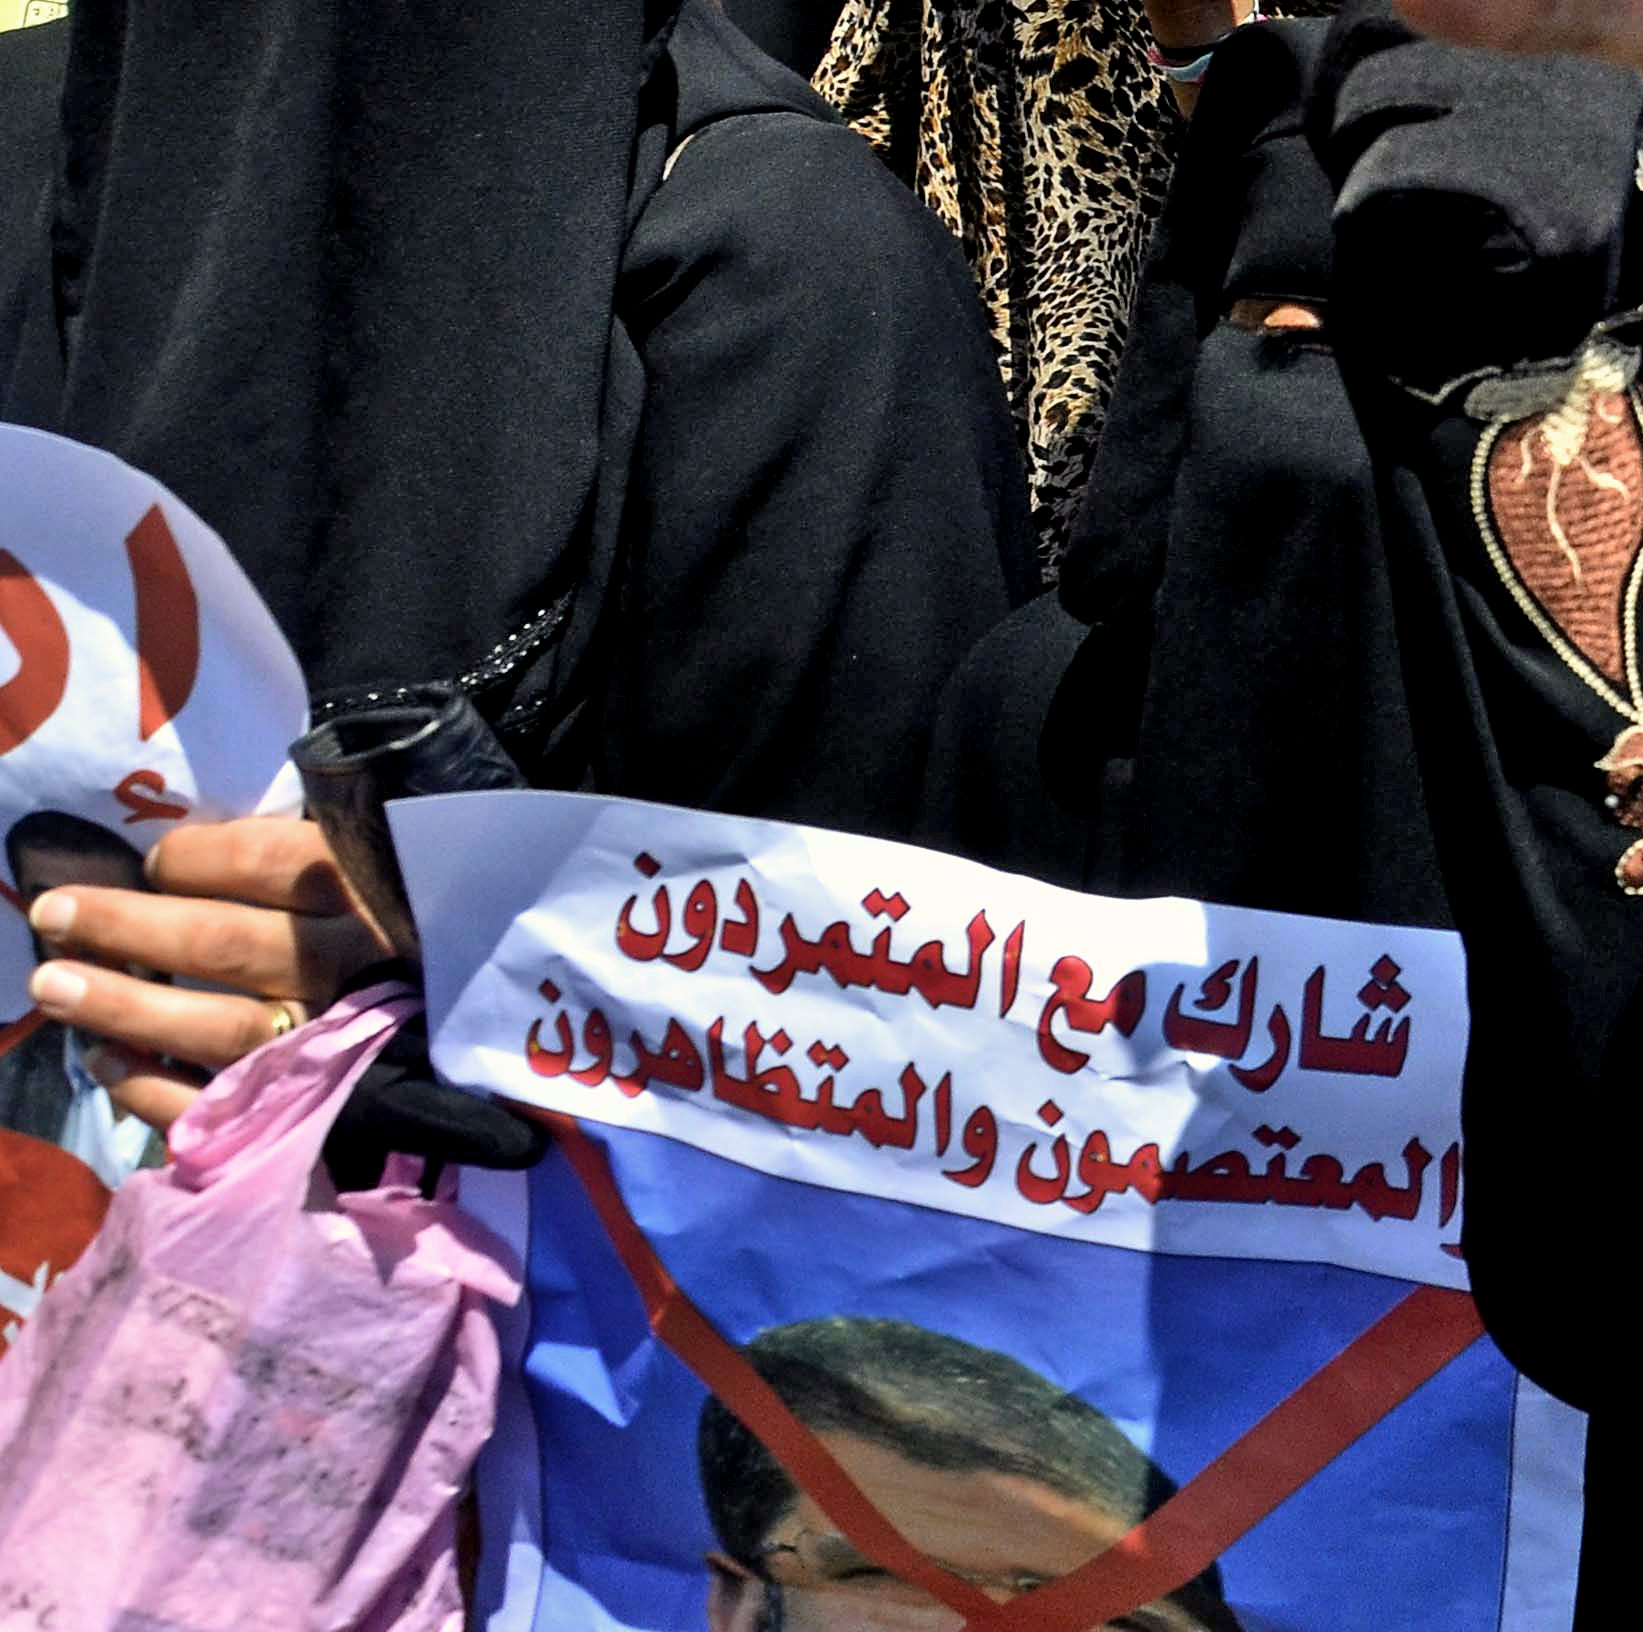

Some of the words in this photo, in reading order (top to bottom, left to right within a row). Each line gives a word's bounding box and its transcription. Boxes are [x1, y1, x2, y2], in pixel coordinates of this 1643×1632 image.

[616, 851, 1026, 1019] المتمردون
[1037, 954, 1147, 1074] مع
[525, 978, 1000, 1190] والمتظاهرون
[1162, 954, 1413, 1093] شارك
[1015, 1097, 1466, 1257] المعتصمون
